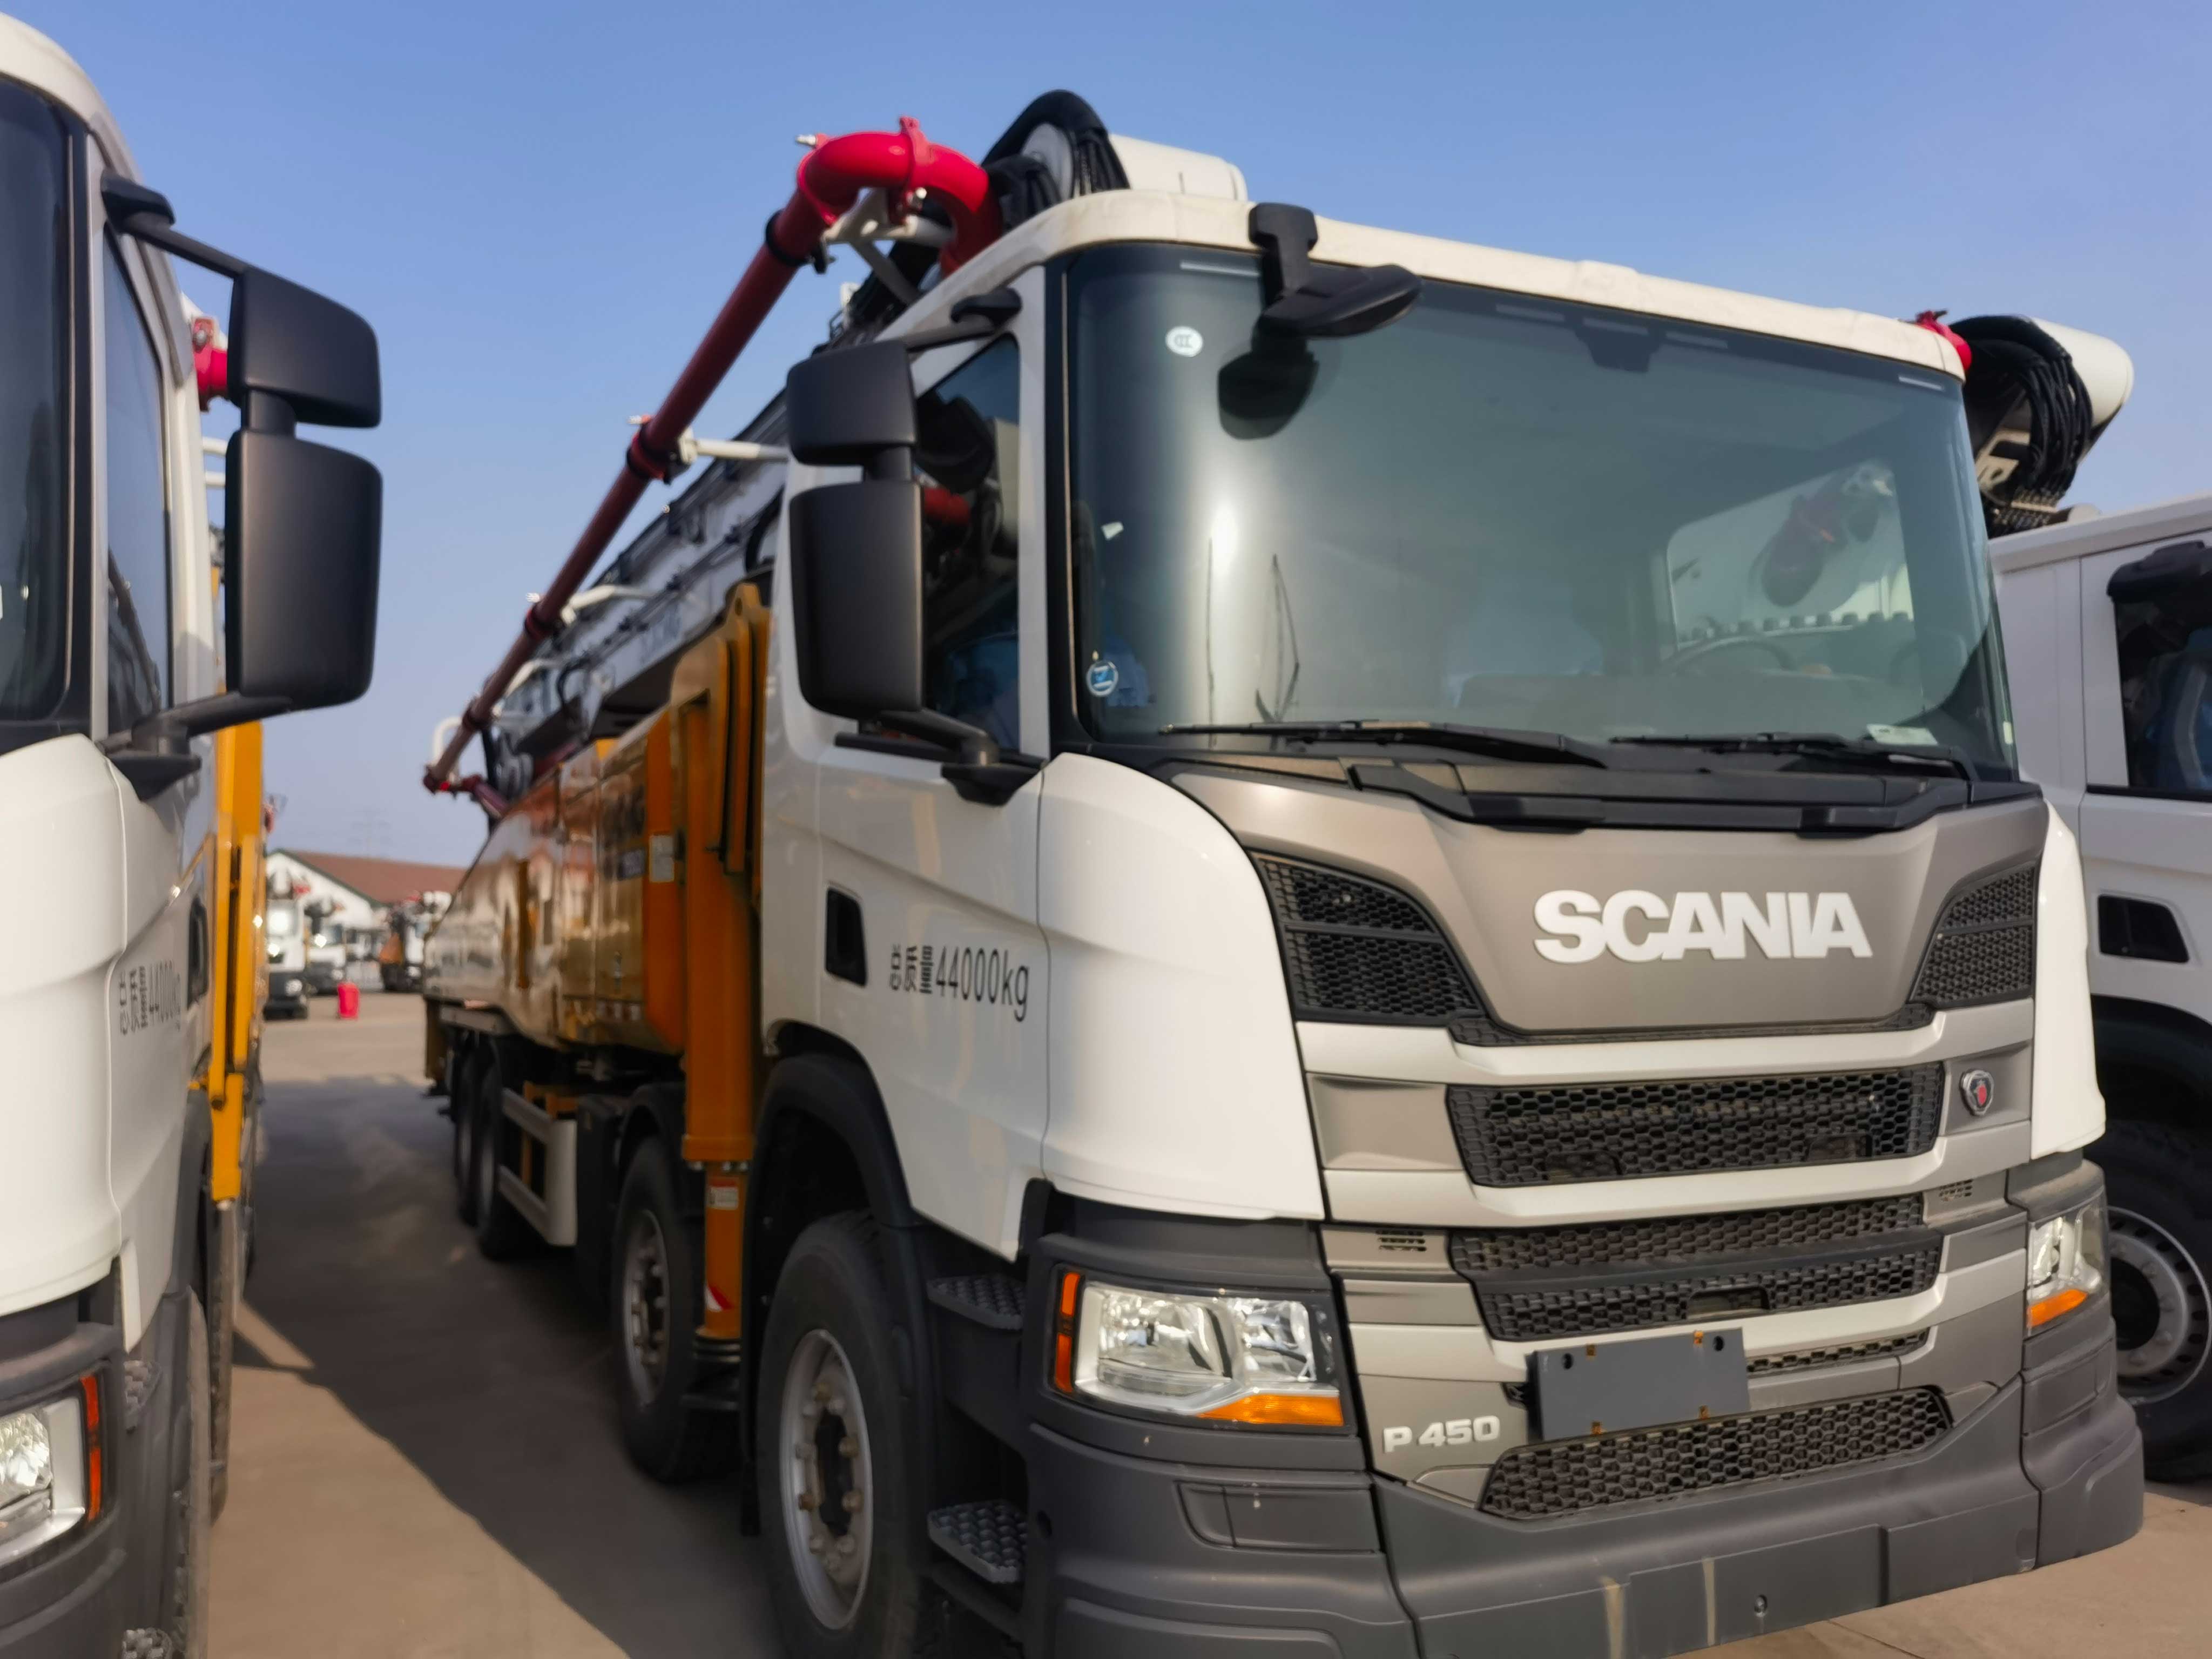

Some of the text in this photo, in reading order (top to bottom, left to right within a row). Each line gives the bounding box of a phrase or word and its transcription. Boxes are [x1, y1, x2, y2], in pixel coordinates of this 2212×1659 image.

[1534, 889, 1873, 963] SCANIA
[890, 944, 1029, 1022] 总质量44000kg
[1383, 1415, 1500, 1453] P 450
